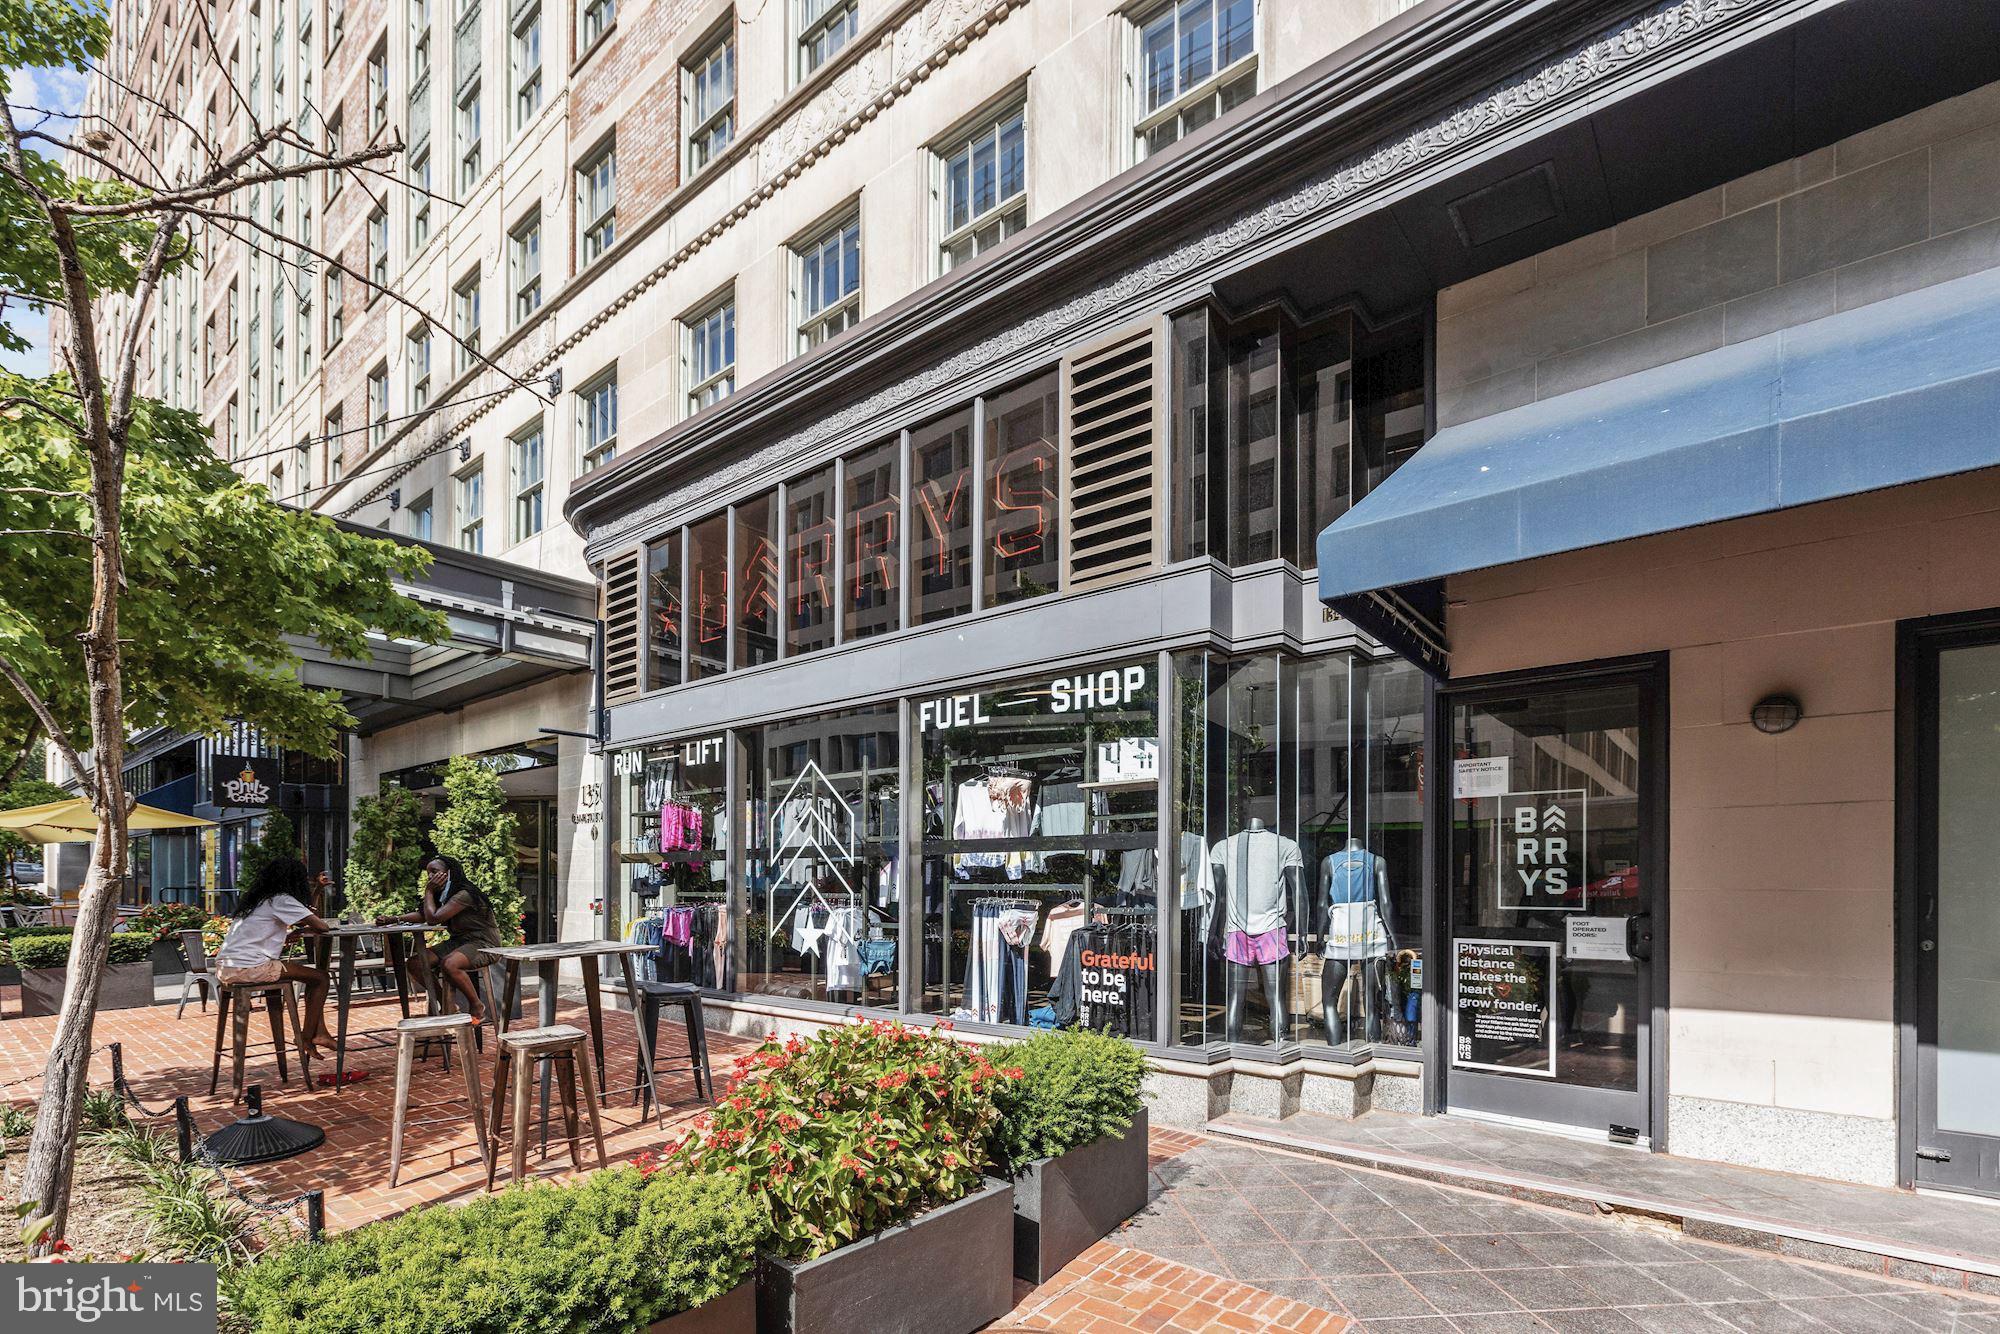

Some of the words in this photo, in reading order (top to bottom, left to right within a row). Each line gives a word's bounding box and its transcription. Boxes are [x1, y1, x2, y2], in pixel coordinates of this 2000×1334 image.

[920, 694, 990, 732] FUEL
[1051, 665, 1145, 713] SHOP
[614, 751, 642, 776] RUN
[686, 737, 723, 766] LIFT
[231, 792, 266, 804] Coffee
[1460, 944, 1514, 956] Physical
[1081, 949, 1155, 971] Grateful
[1460, 956, 1515, 969] distance
[1081, 968, 1100, 985] to
[1103, 969, 1125, 987] be
[1460, 971, 1501, 982] makes
[1504, 973, 1526, 983] the
[1081, 985, 1124, 1005] here.
[1460, 983, 1493, 995] heart
[1459, 998, 1491, 1008] grow
[1494, 999, 1541, 1012] fonder.
